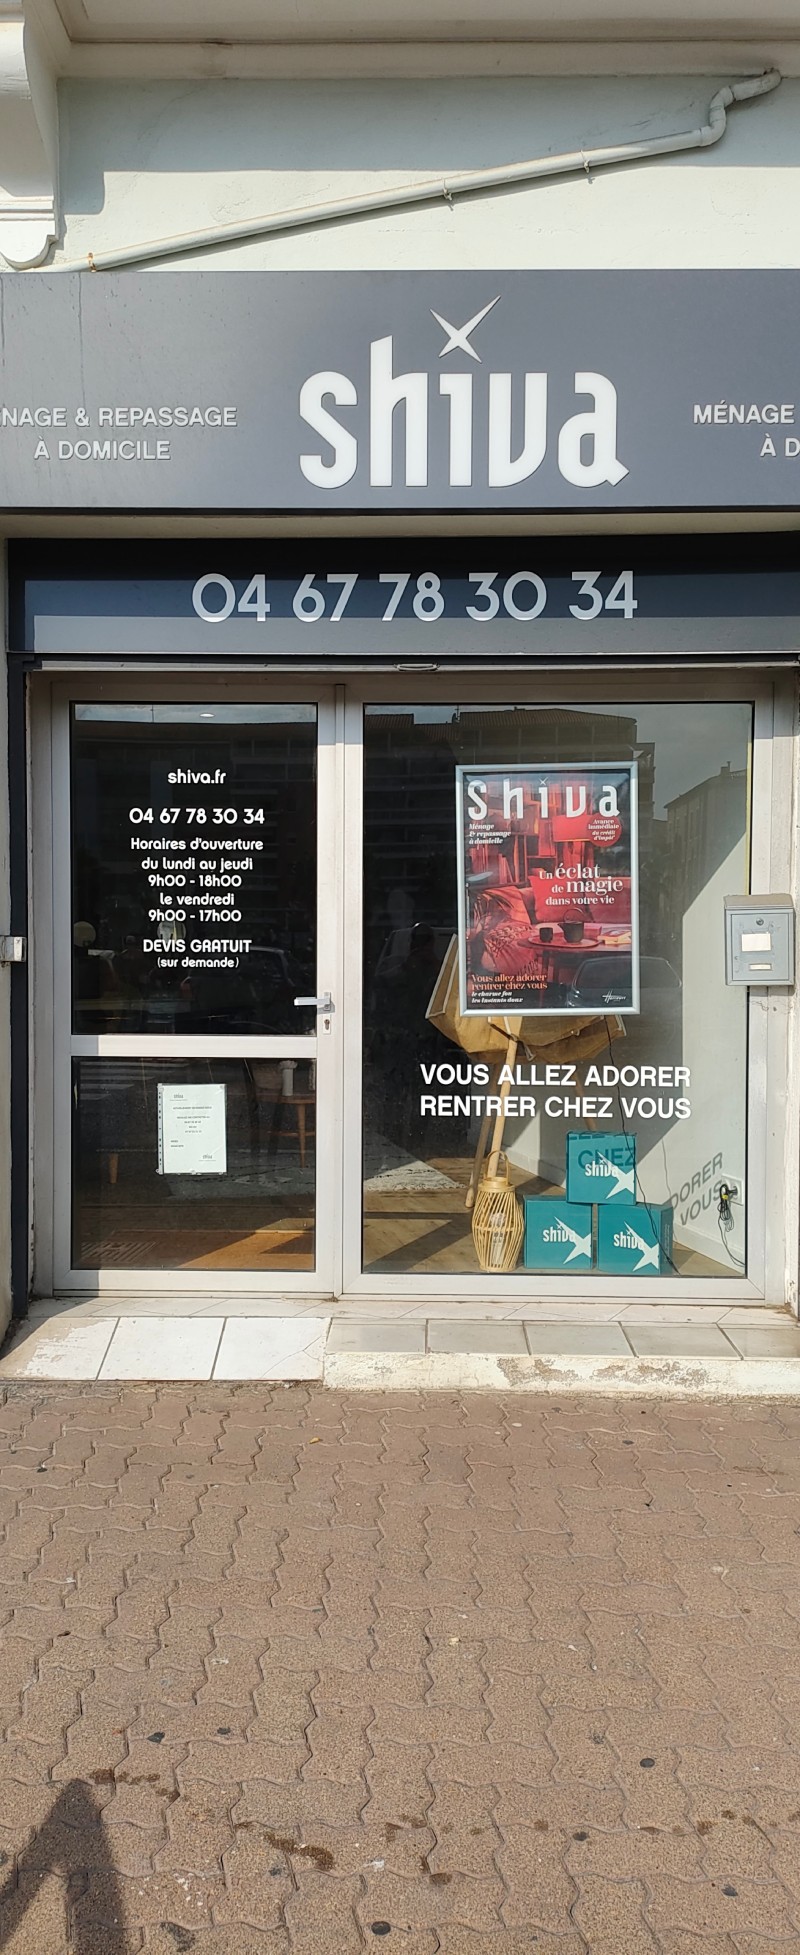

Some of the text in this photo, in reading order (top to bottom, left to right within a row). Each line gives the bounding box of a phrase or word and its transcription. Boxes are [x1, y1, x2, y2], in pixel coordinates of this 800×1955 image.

[300, 297, 629, 489] shiva
[0, 407, 238, 427] NAGE & REPASSAGE
[693, 400, 795, 424] MÉNAGE
[33, 436, 171, 460] À DOMICILE
[760, 432, 777, 457] À
[192, 571, 638, 622] 04 67 78 30 34
[167, 769, 227, 784] shiva.fr
[467, 777, 620, 821] Shiva
[129, 808, 265, 824] 04 67 78 30 34
[130, 837, 264, 850] Horaires d'ouverture
[141, 857, 253, 873] du lundi au jeudi
[539, 863, 600, 879] Un éclat
[148, 874, 186, 887] 9h00
[199, 874, 242, 887] 18h00
[551, 876, 623, 896] de magie
[159, 893, 235, 906] le vendredi
[545, 896, 571, 905] dans
[600, 895, 615, 904] vie
[148, 909, 186, 923] 9h00
[199, 909, 242, 922] 17h00
[143, 938, 253, 953] DEVIS GRATUIT
[157, 957, 240, 968] (sur demande)
[471, 973, 547, 982] Vous allez adorer
[471, 982, 504, 991] rentrer
[505, 981, 525, 990] chez
[420, 1064, 691, 1087] VOUS ALLEZ ADORER
[420, 1096, 691, 1119] RENTRER CHEZ VOUS
